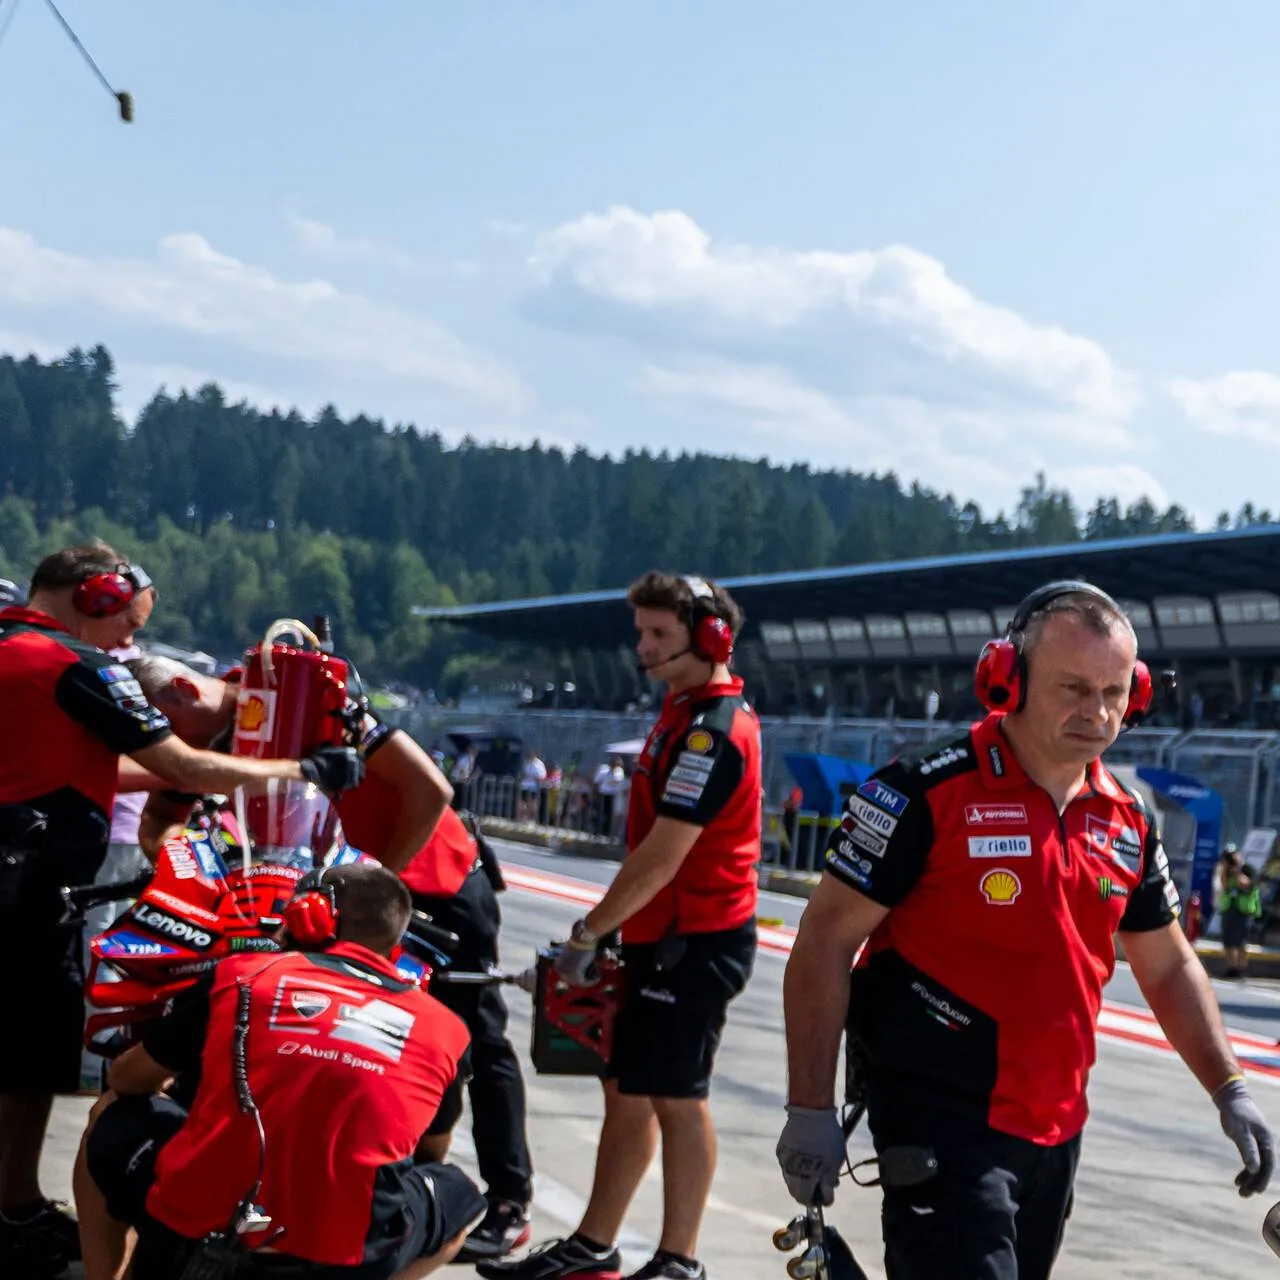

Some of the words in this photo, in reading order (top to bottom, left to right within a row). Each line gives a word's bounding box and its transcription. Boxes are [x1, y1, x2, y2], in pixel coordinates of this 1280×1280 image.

[874, 787, 899, 809] TIM
[859, 803, 892, 831] riello
[988, 839, 1027, 852] riello
[1112, 839, 1141, 856] Lenovo
[134, 904, 212, 947] Lenovo
[128, 943, 163, 955] TIM
[300, 1043, 338, 1061] Audi
[342, 1052, 386, 1076] Sport
